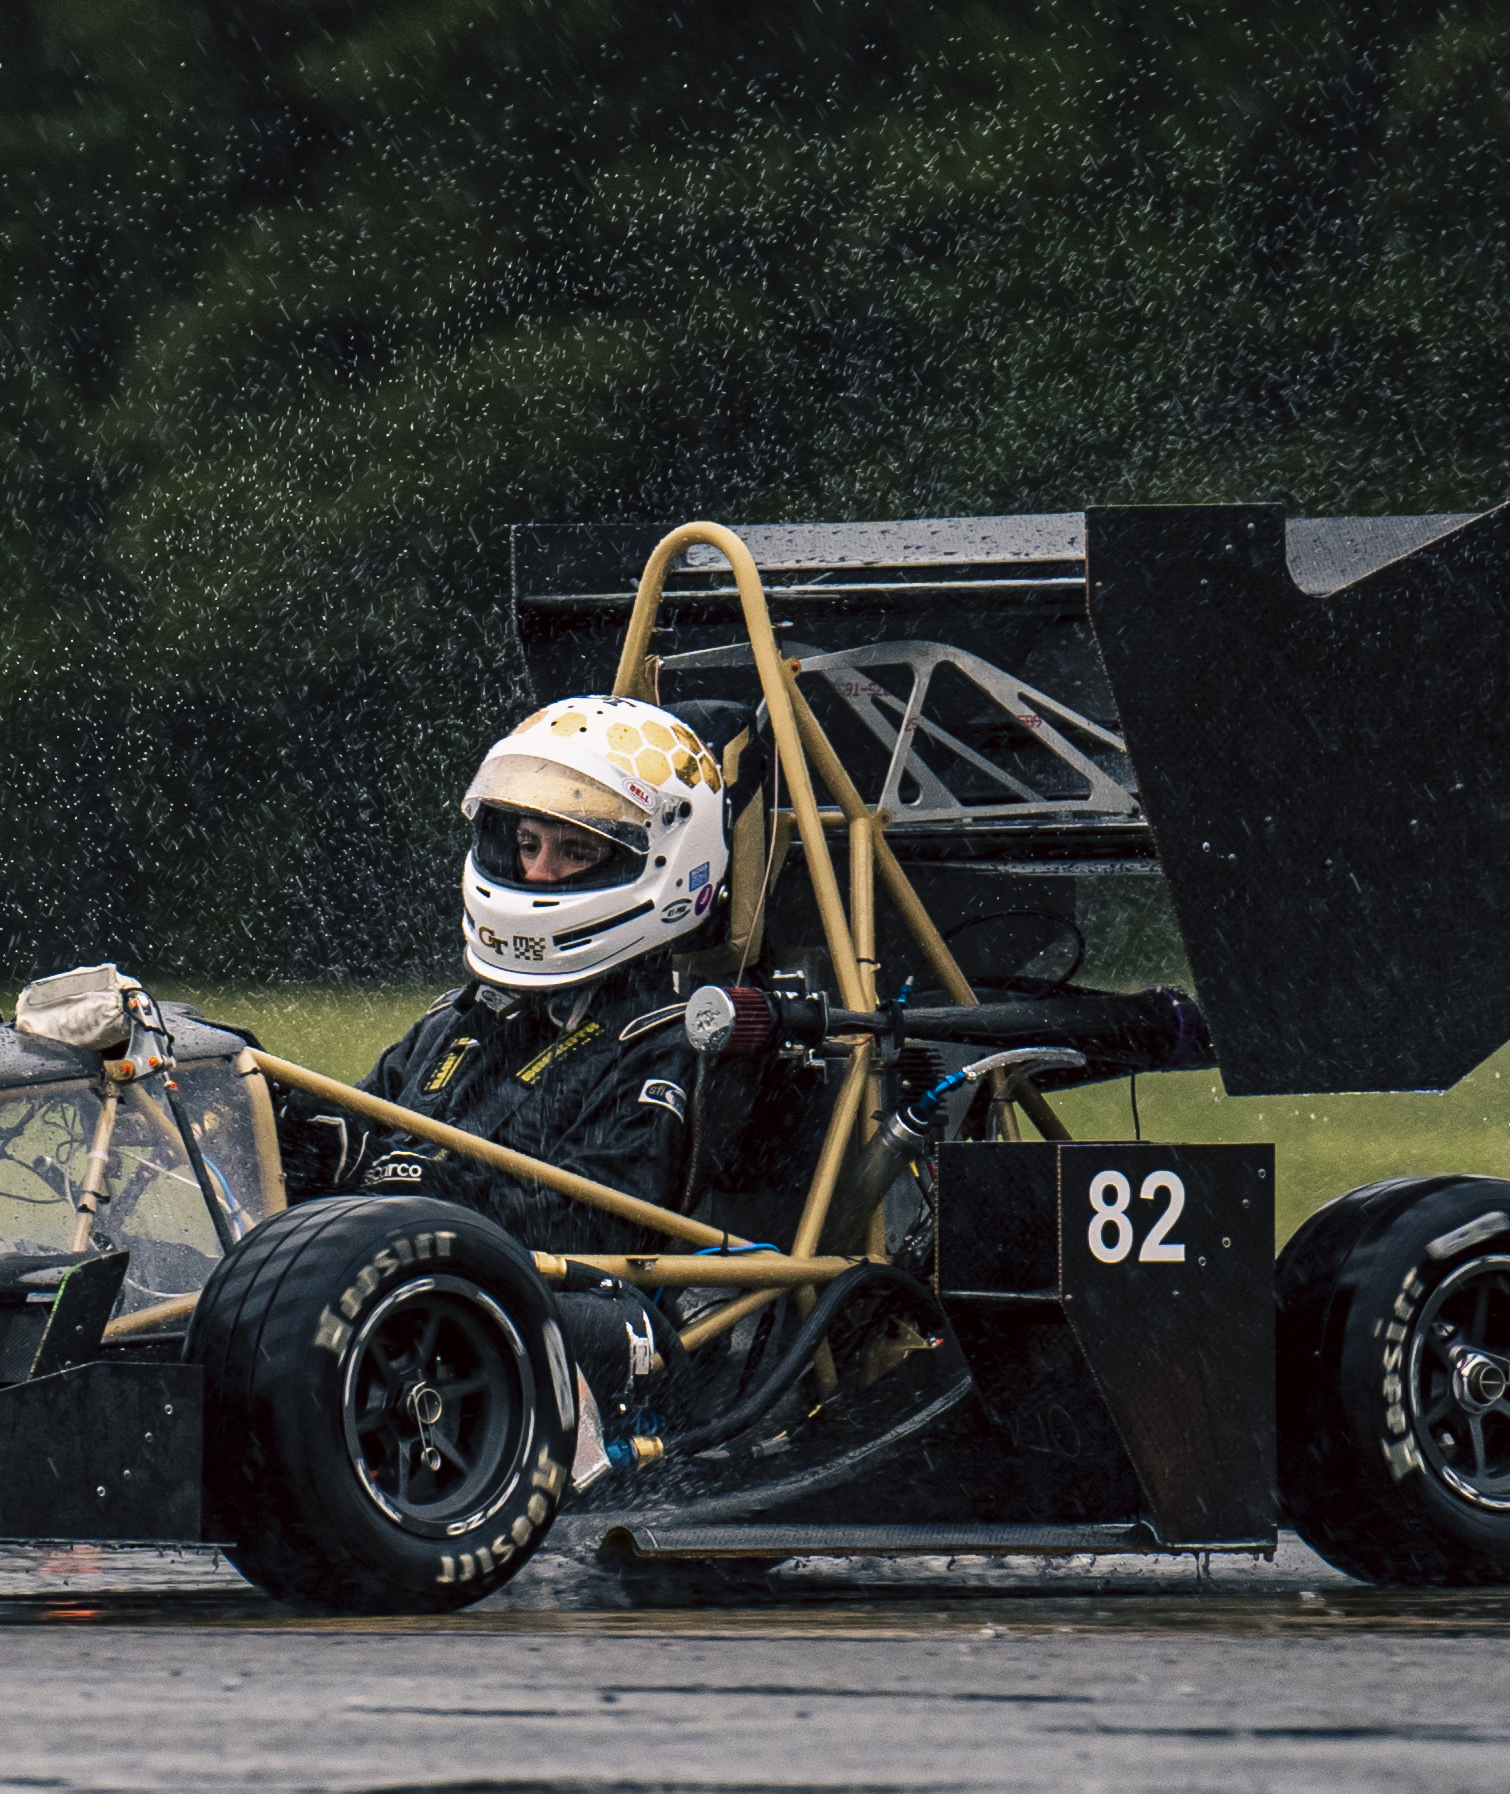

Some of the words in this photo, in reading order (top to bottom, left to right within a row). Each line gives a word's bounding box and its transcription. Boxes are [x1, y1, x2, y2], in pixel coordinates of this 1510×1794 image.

[629, 783, 649, 804] BELL
[478, 925, 509, 956] GT
[1088, 1170, 1186, 1264] 82
